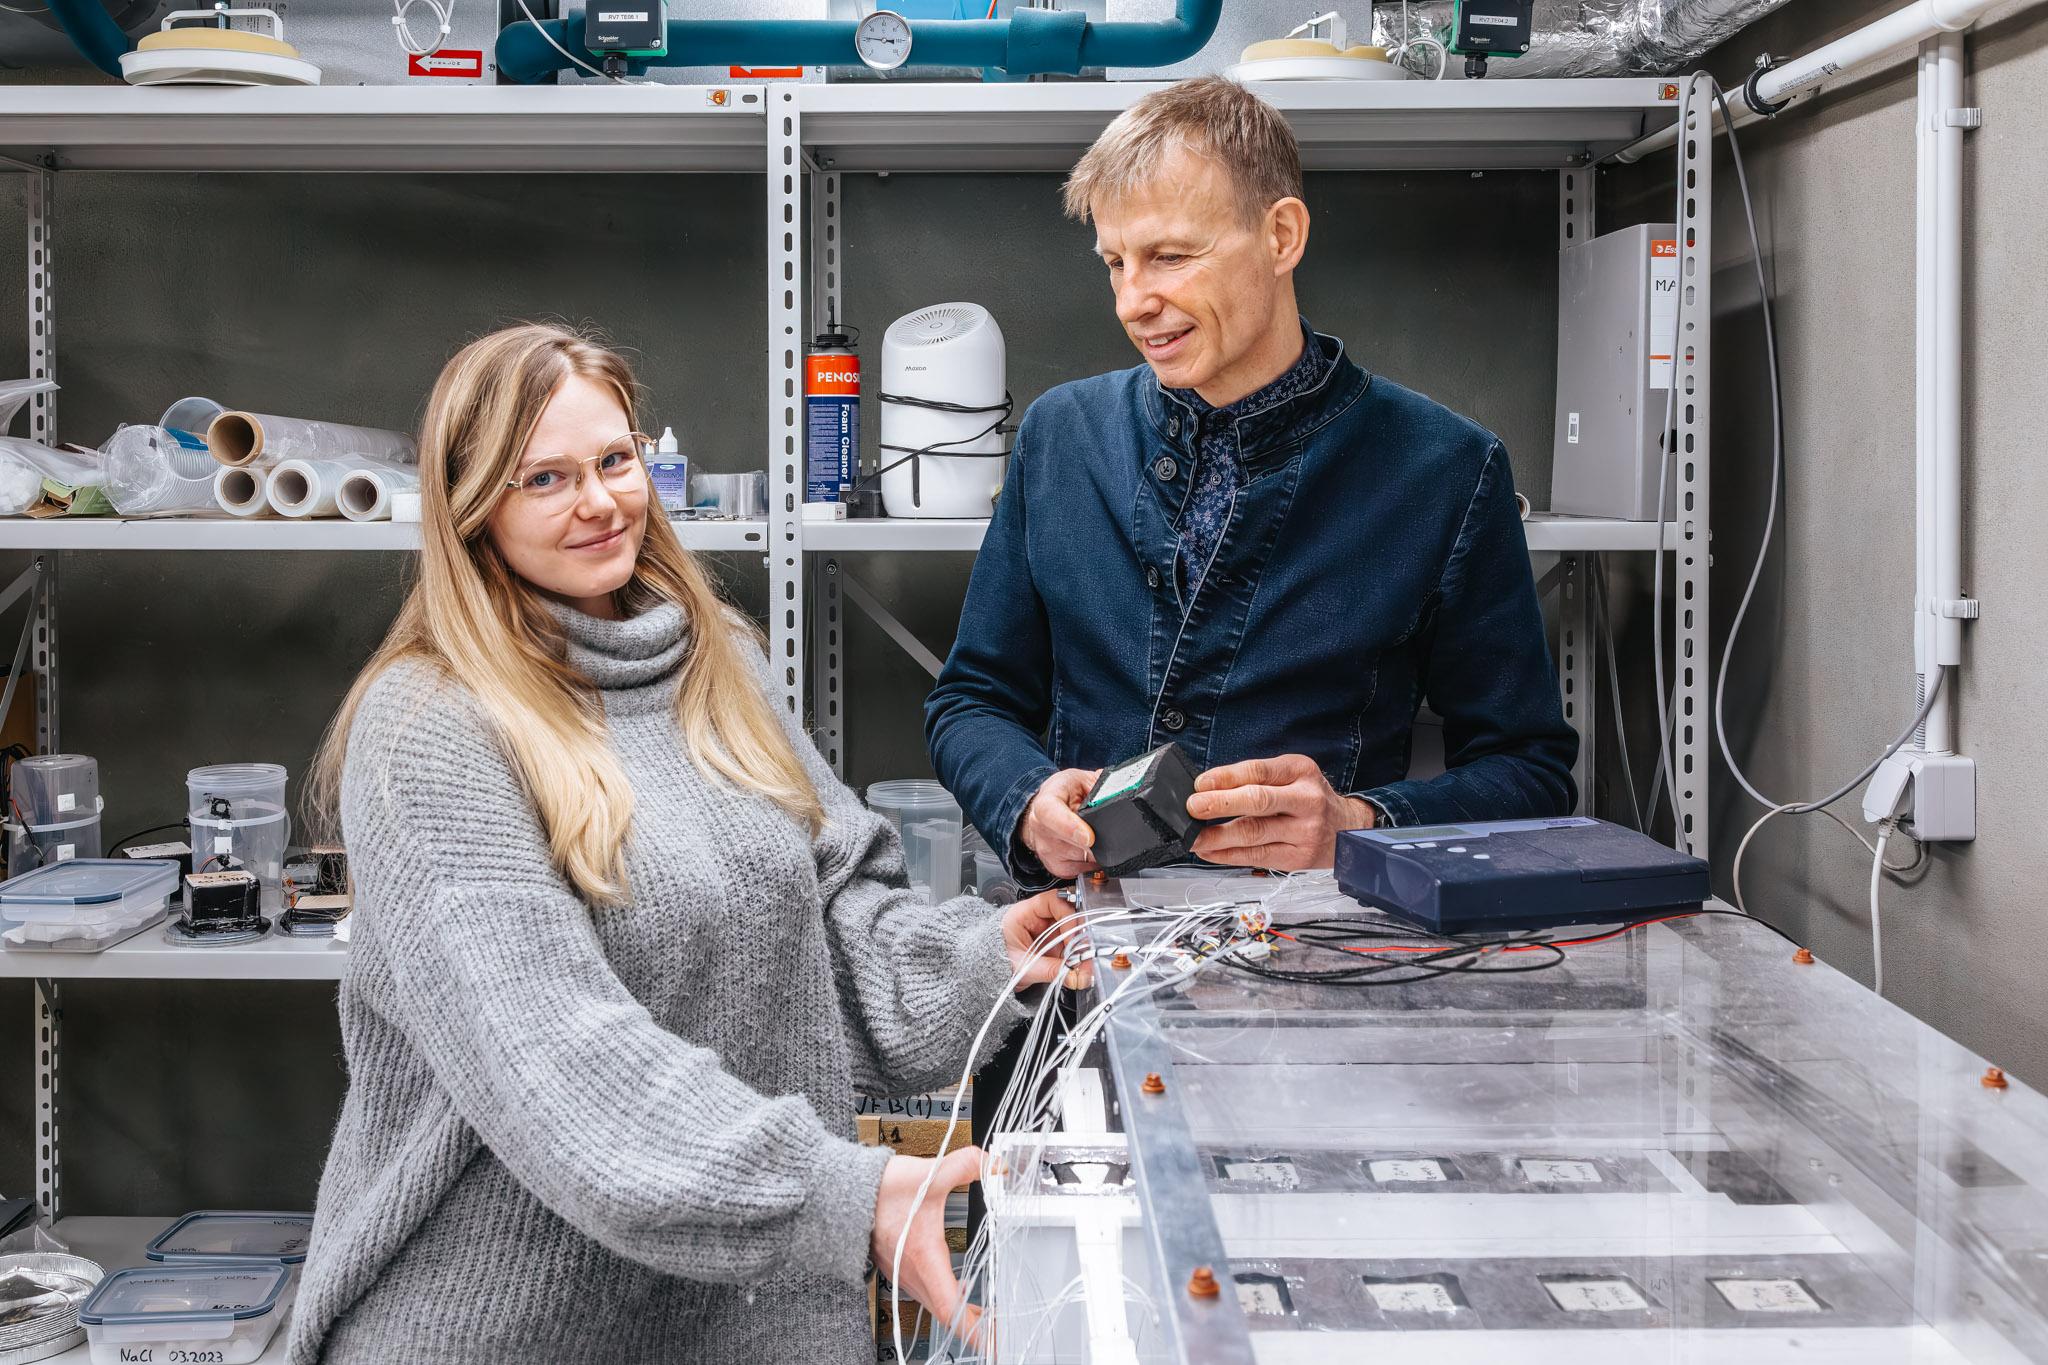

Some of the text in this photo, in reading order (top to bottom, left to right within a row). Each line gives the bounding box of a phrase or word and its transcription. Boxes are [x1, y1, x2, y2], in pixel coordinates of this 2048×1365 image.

[841, 404, 850, 480] Foam Cleaner
[120, 1348, 224, 1364] NaCl 03.2023
